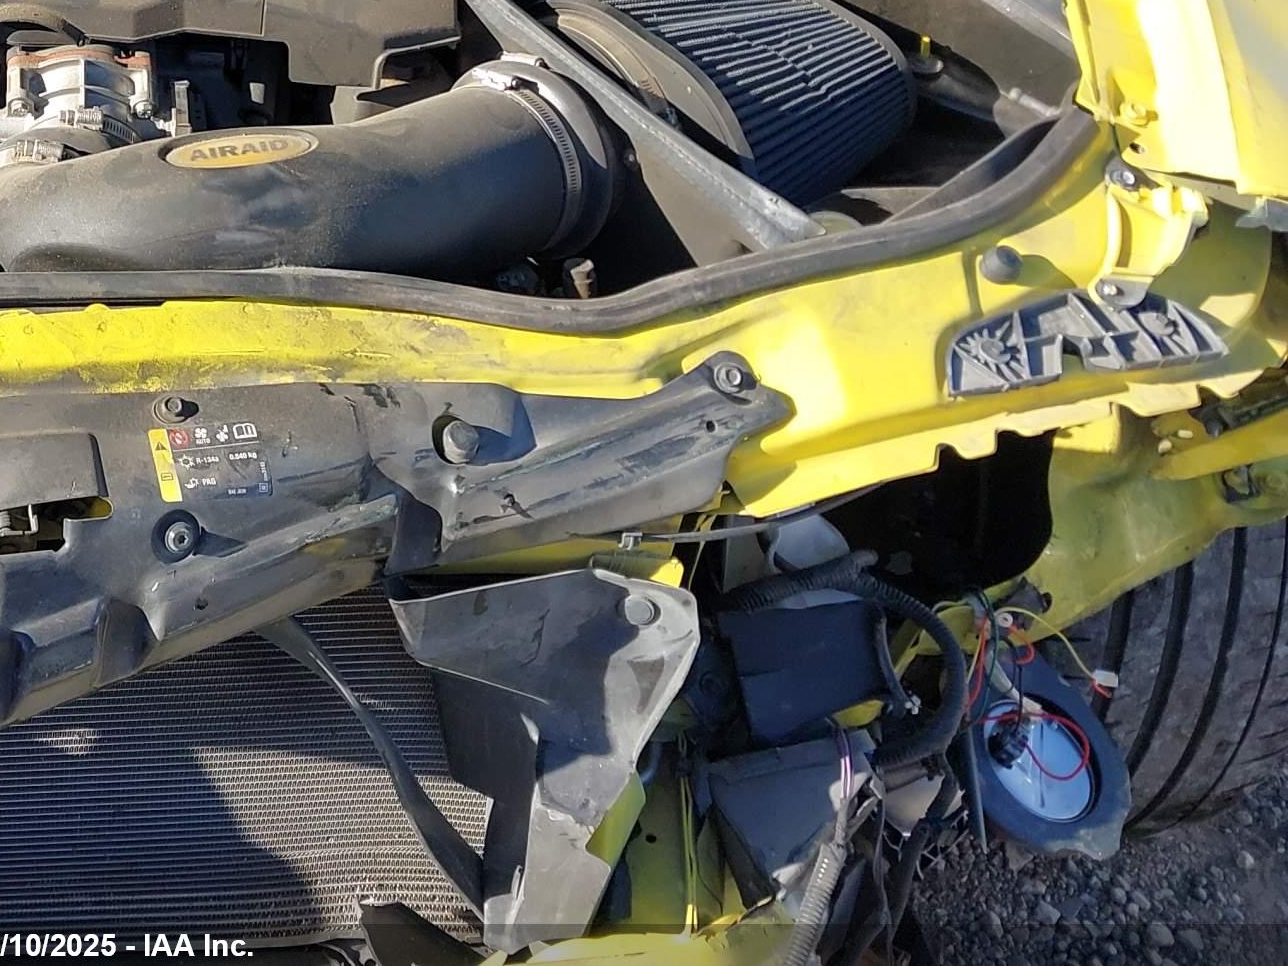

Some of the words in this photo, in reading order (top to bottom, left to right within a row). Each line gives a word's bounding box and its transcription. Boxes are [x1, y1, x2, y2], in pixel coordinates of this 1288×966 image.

[190, 139, 289, 162] AIRAID
[195, 437, 211, 445] AUTO
[196, 456, 220, 464] R-134a
[248, 451, 258, 459] kg
[202, 477, 217, 486] PAG
